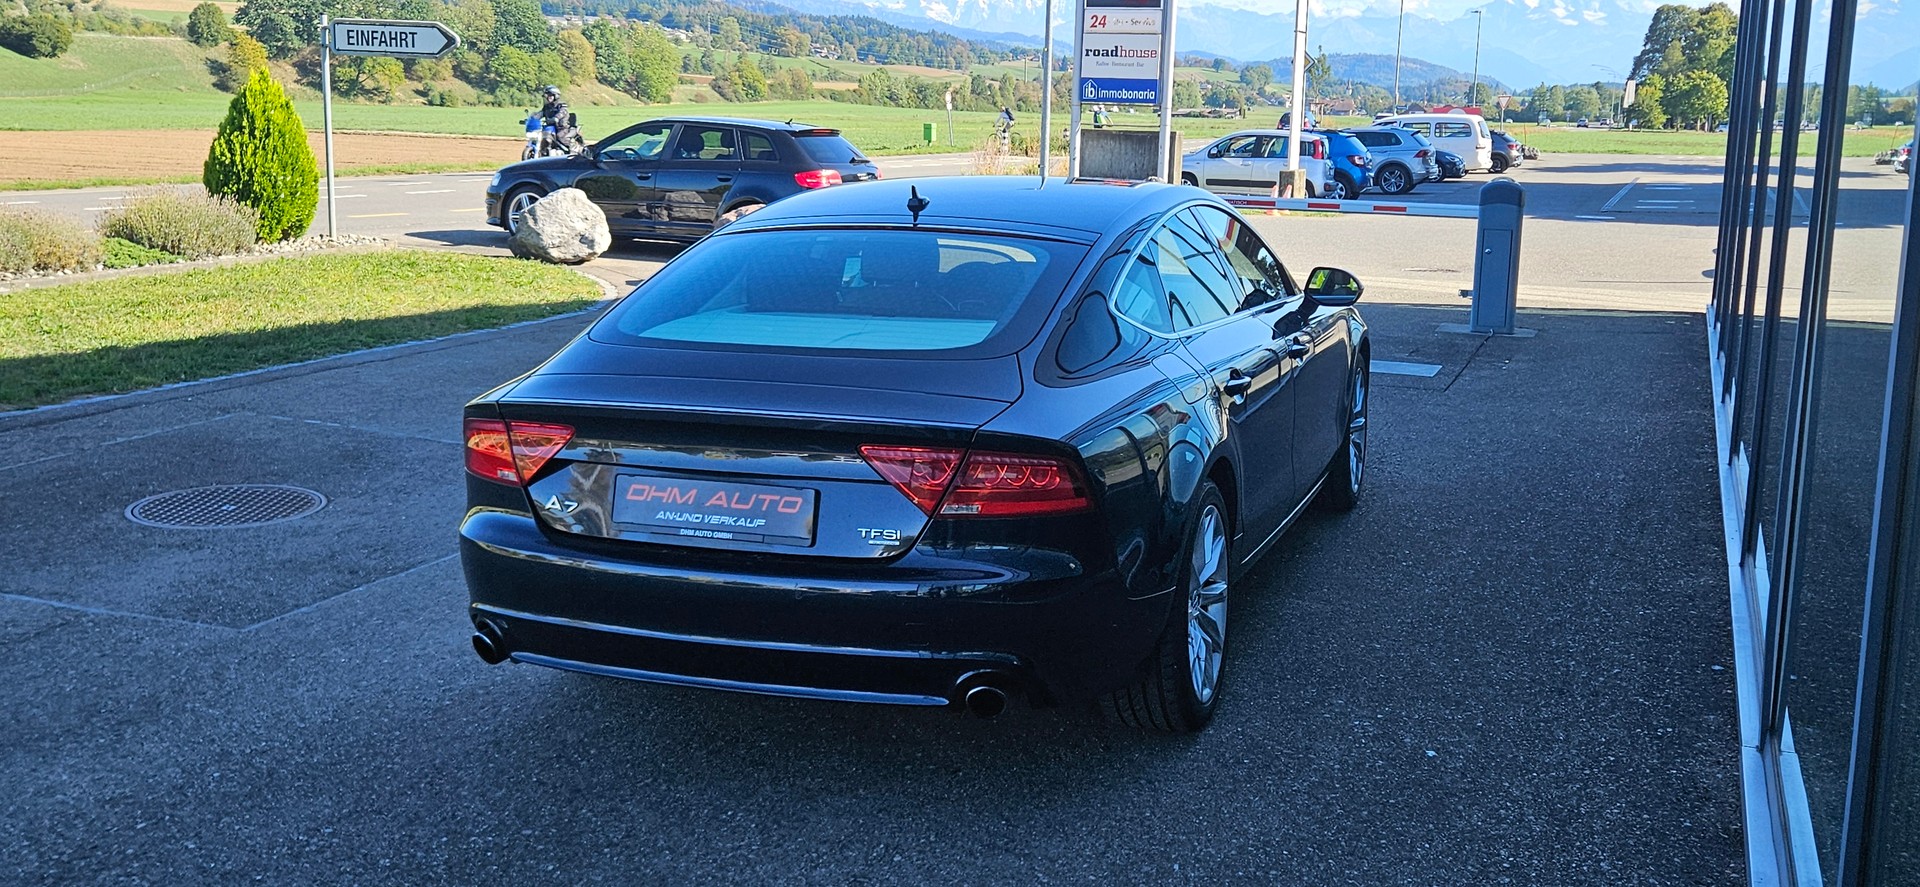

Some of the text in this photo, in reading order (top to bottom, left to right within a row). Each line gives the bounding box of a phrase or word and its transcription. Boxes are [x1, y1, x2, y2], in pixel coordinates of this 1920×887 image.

[1089, 14, 1107, 29] 24
[346, 29, 418, 48] EINFAHRT
[1084, 45, 1158, 59] roadhouse
[1085, 82, 1156, 100] ib immobonaria
[545, 494, 579, 513] A7
[626, 484, 803, 514] DHM AUTO
[704, 514, 766, 528] VERKAUF
[695, 530, 713, 538] AUTO
[857, 528, 901, 540] TFSI
